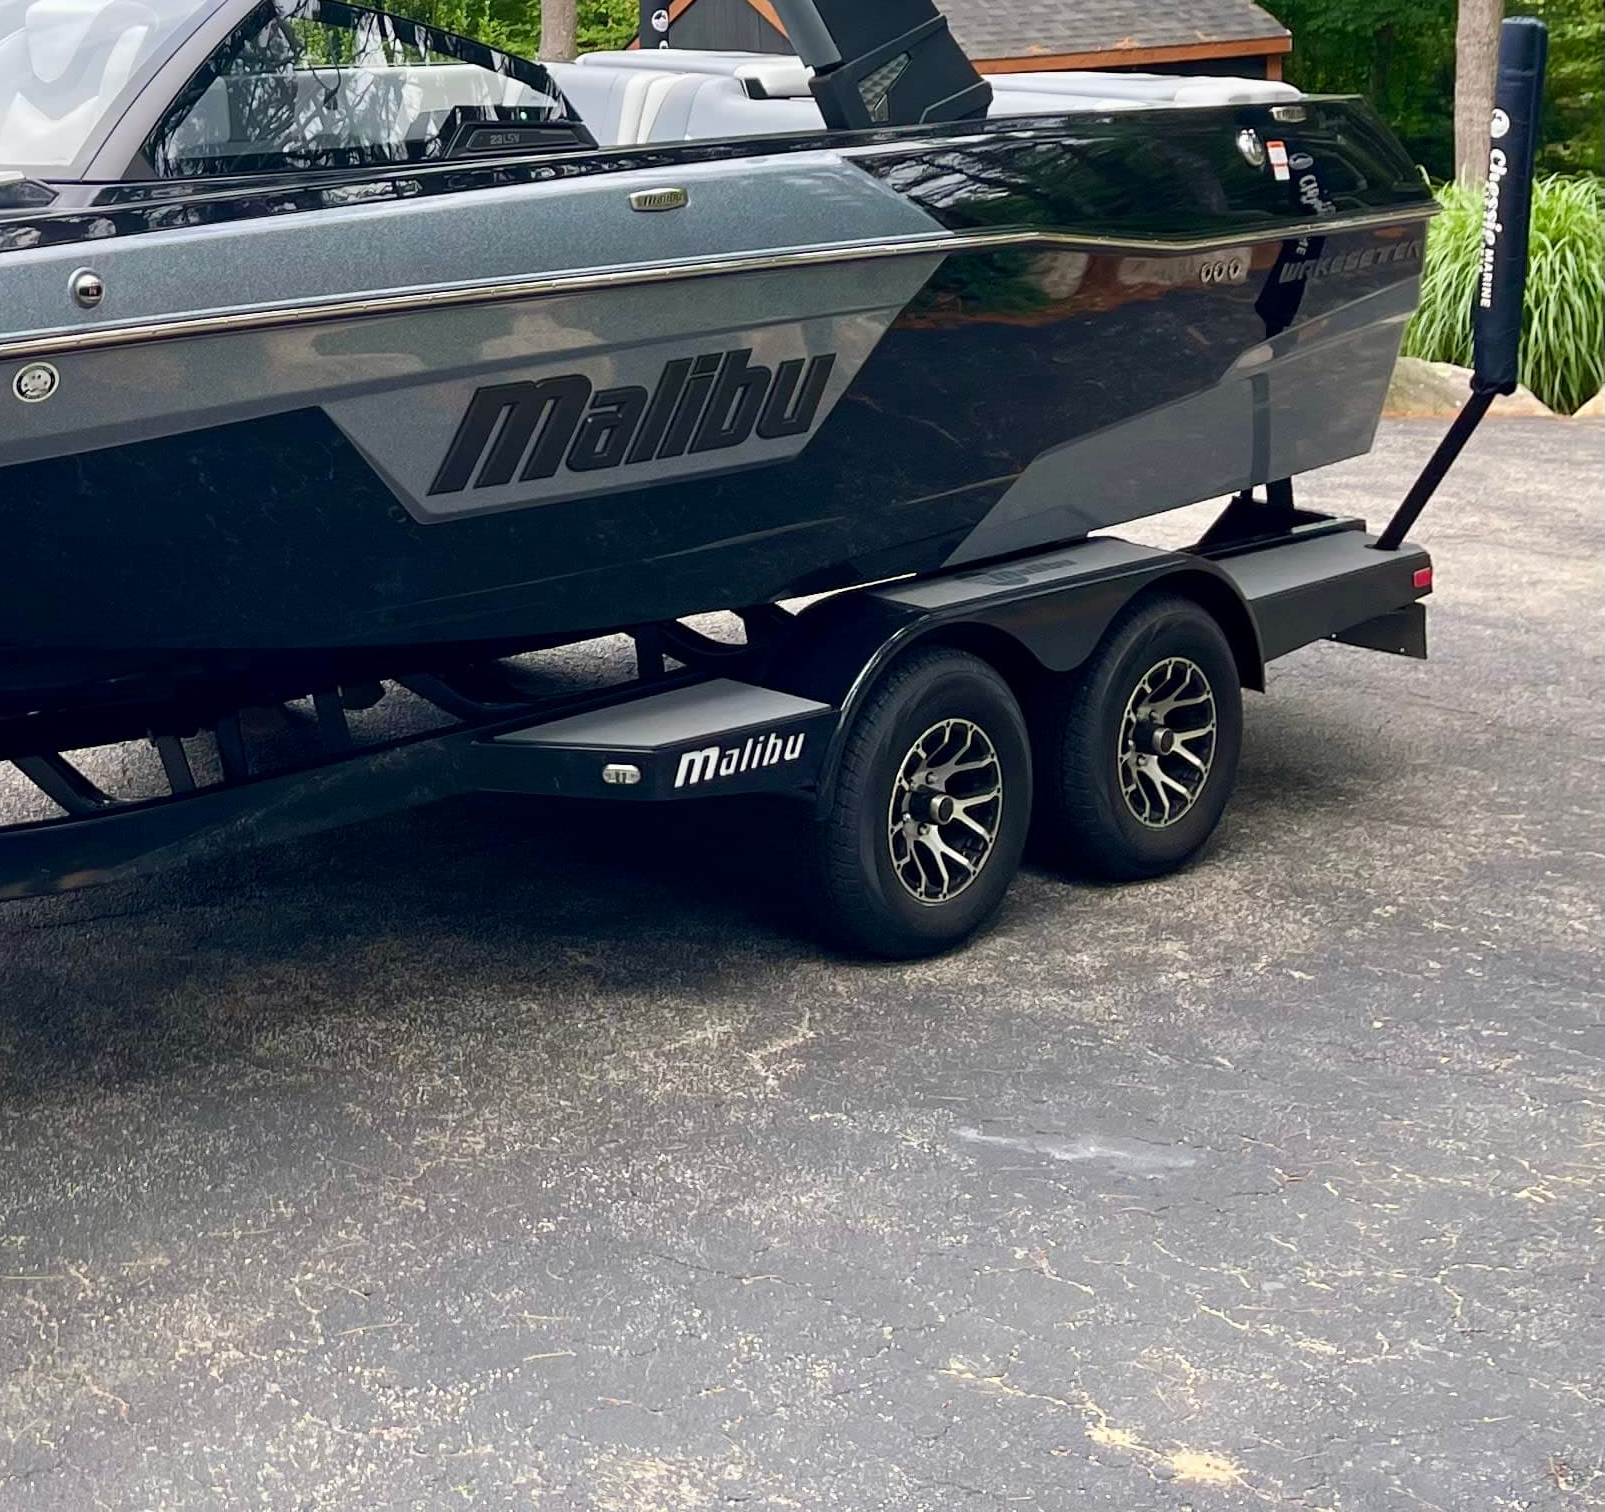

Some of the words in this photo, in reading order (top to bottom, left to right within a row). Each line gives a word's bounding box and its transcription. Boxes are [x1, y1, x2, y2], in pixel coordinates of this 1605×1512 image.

[1484, 148, 1508, 246] Chessie
[1479, 248, 1495, 309] MARINE
[425, 347, 838, 498] Malibu
[673, 732, 806, 789] Malibu
